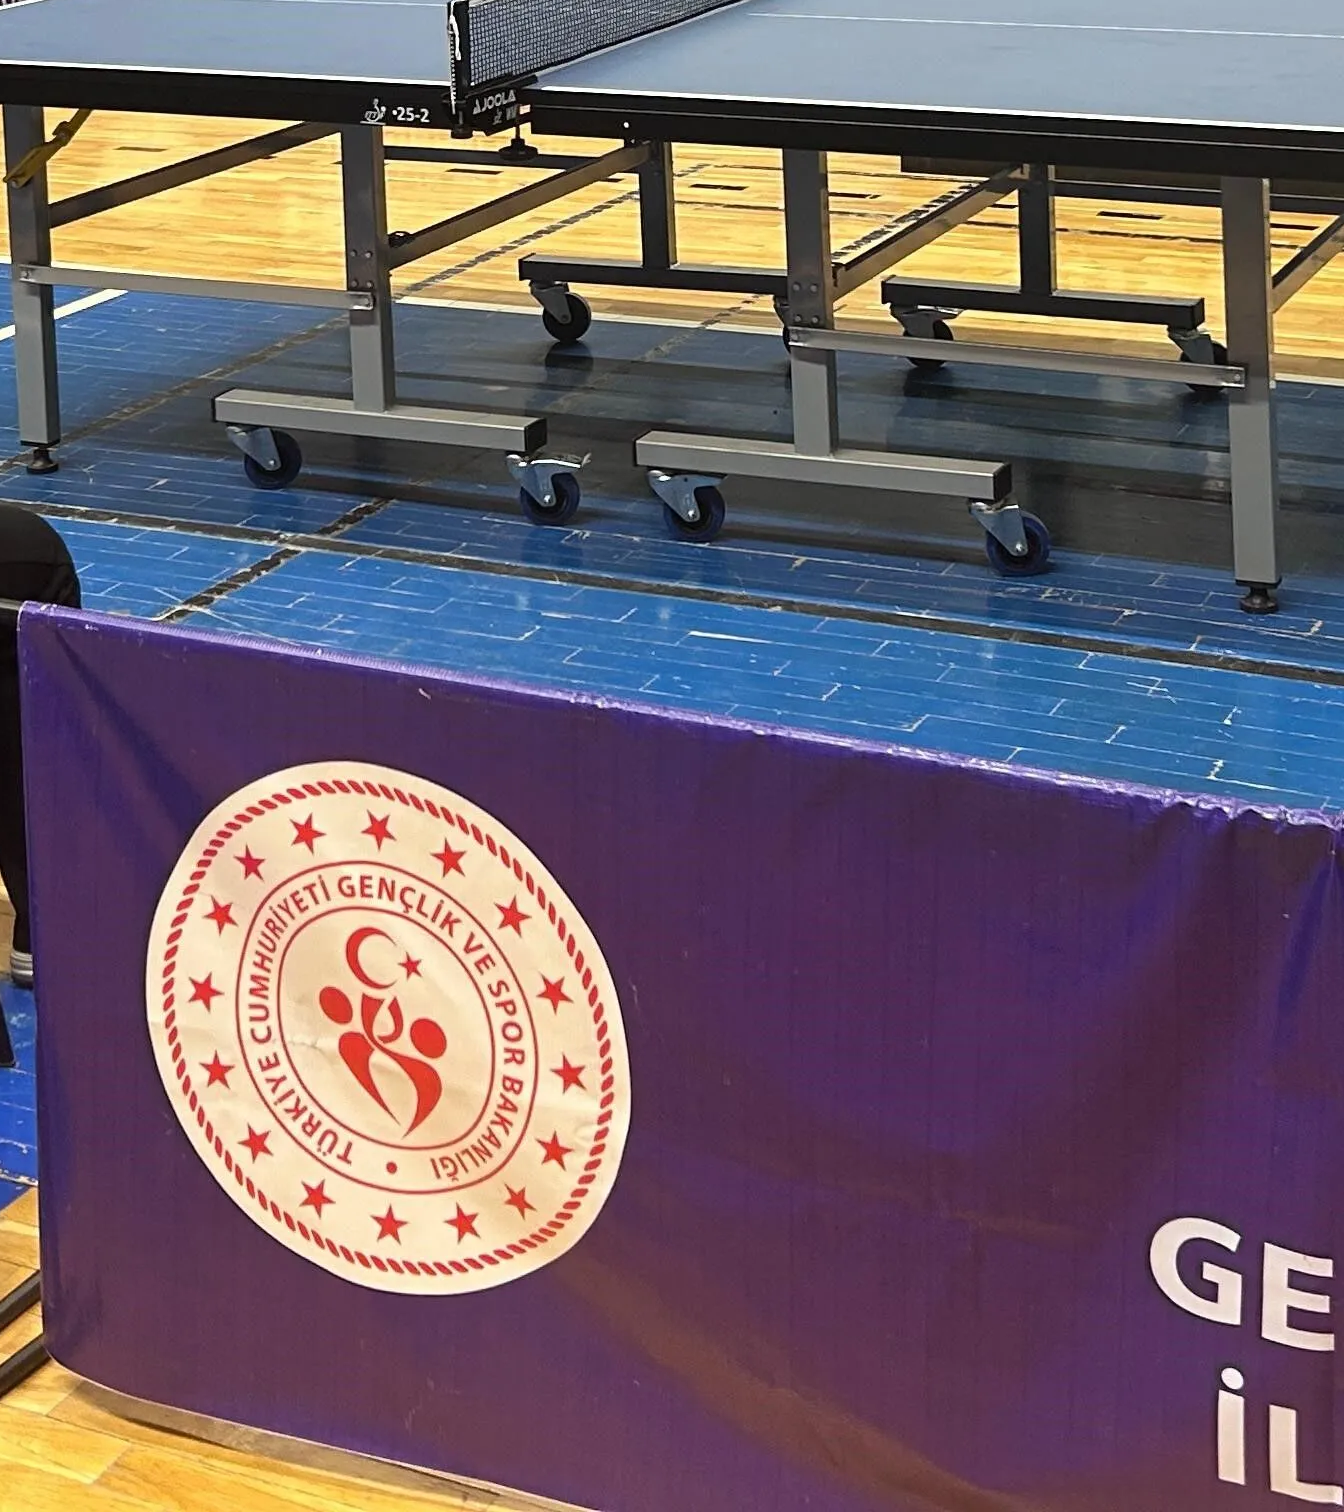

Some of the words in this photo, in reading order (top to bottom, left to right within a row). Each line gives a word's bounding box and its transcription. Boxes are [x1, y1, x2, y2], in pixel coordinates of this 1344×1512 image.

[249, 874, 331, 1042] CUMHURİYETİ
[338, 874, 460, 941] GENÇLİK
[462, 931, 497, 975] VE
[486, 978, 525, 1068] SPOR
[257, 1051, 354, 1166] TÜRKİYE
[430, 1076, 524, 1183] BAKANLIĞI
[1215, 1368, 1344, 1506] İL
